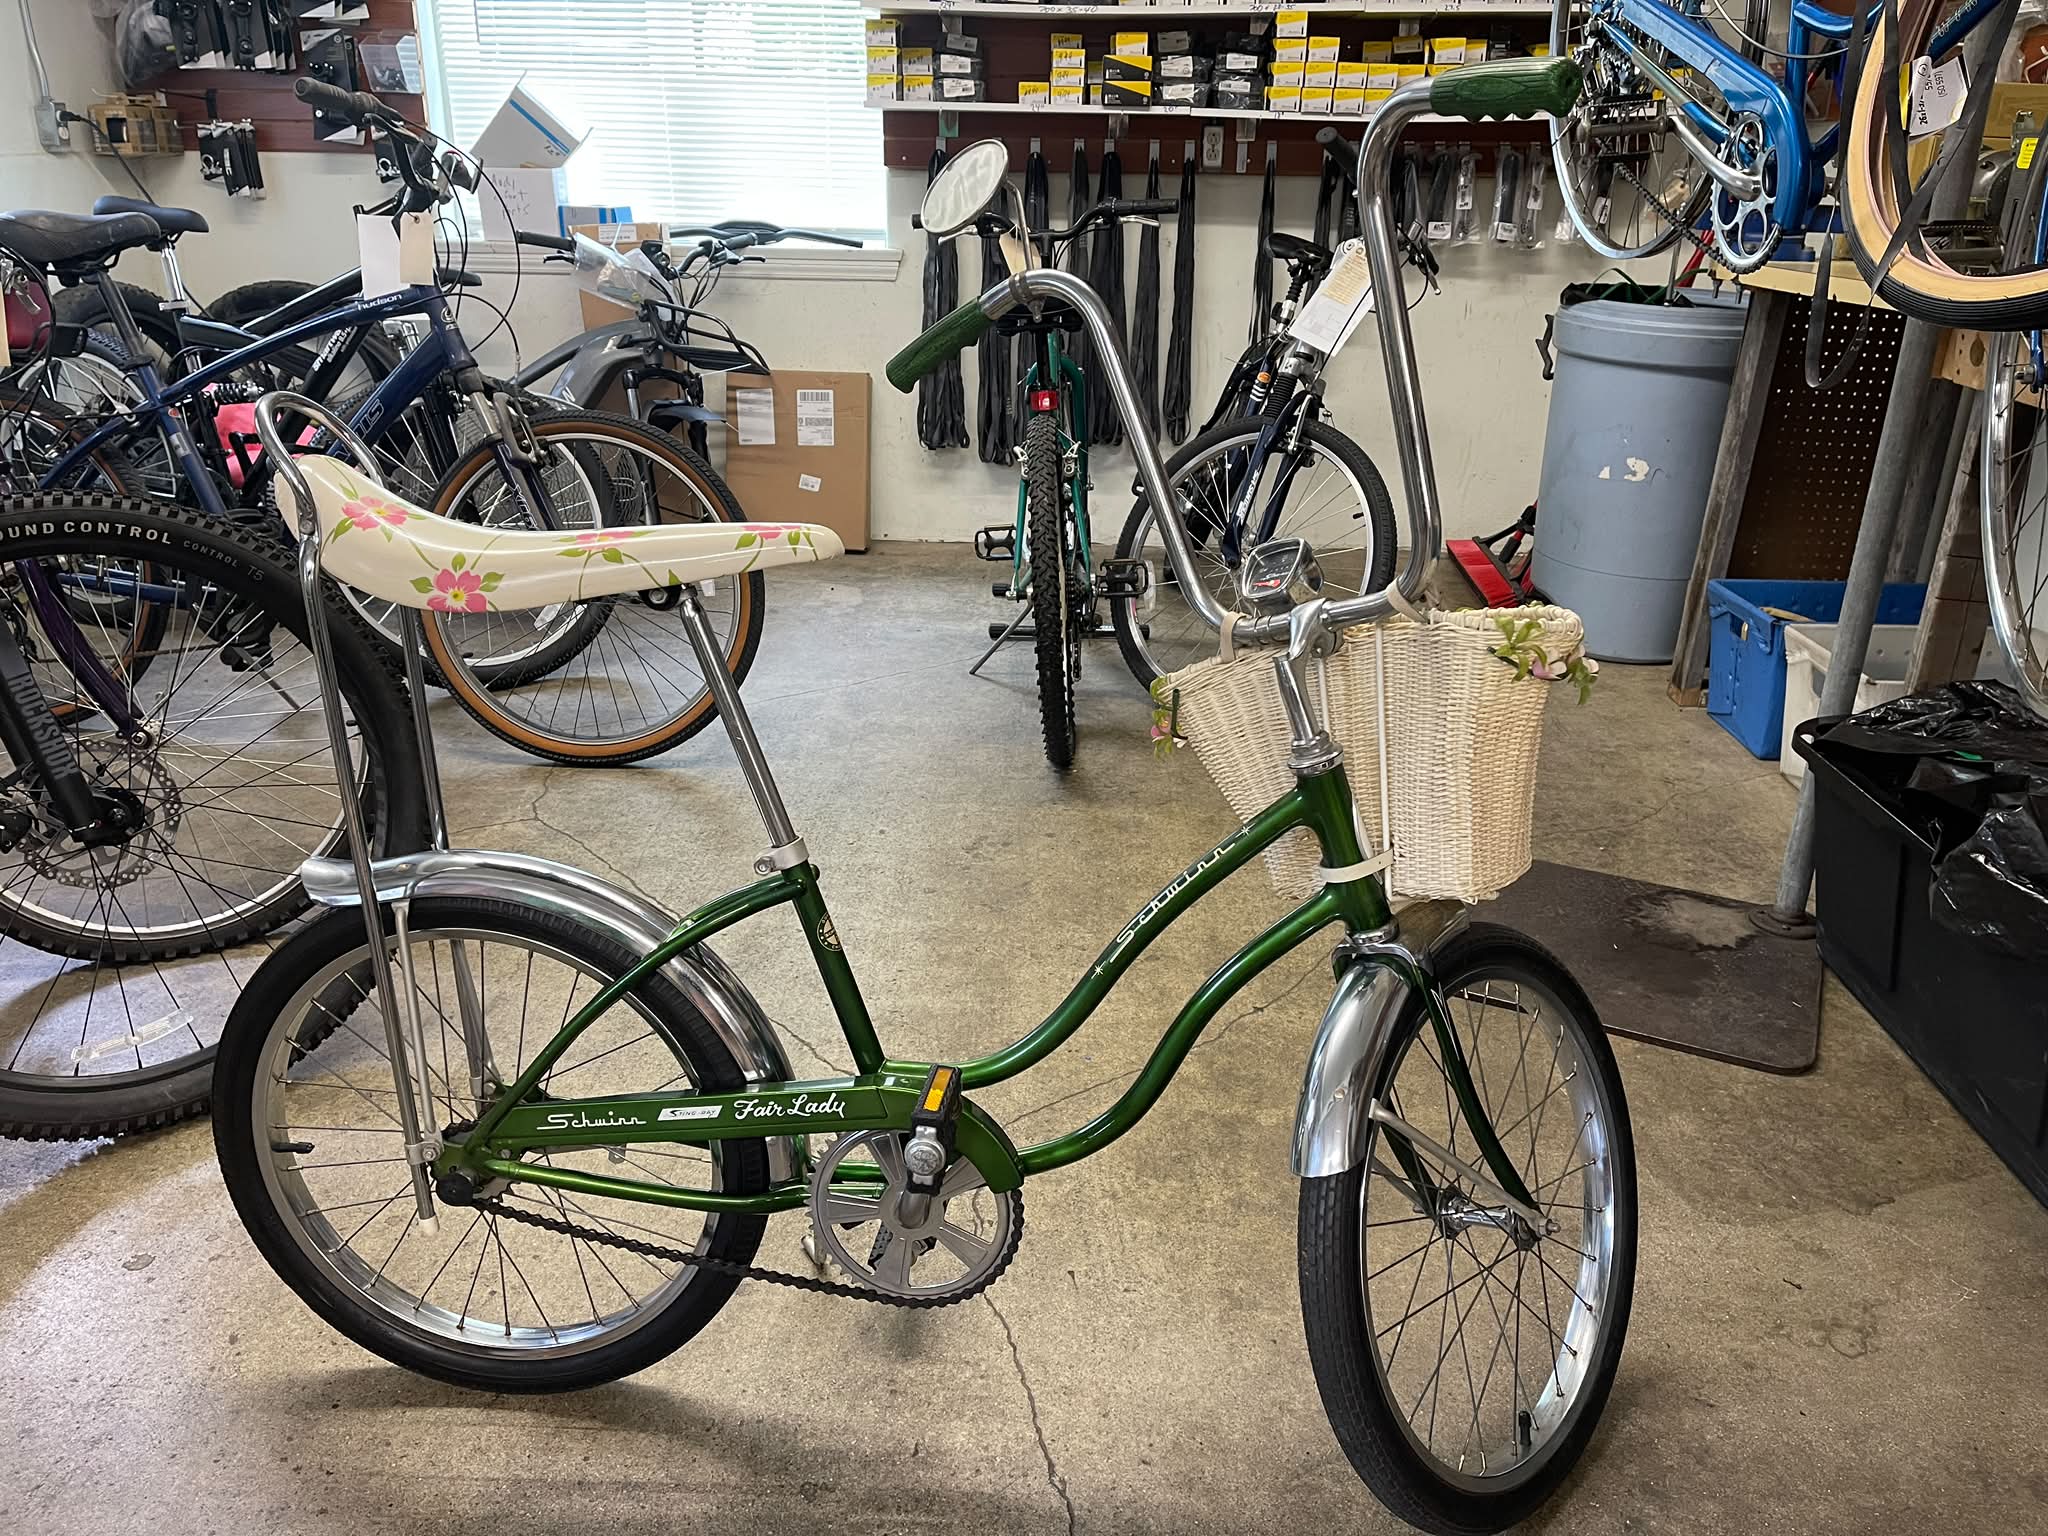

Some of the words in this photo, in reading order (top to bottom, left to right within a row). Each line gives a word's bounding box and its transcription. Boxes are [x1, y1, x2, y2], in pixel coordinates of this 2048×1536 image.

[357, 293, 403, 312] hudson
[0, 522, 55, 542] UND
[64, 520, 172, 545] CONTROL
[183, 540, 240, 567] CONTROL
[13, 674, 80, 781] ROCKSHOX
[1110, 842, 1236, 964] Schwinn
[536, 1110, 647, 1130] Schwinn
[733, 1099, 786, 1119] Fair
[786, 1092, 846, 1120] Lady
